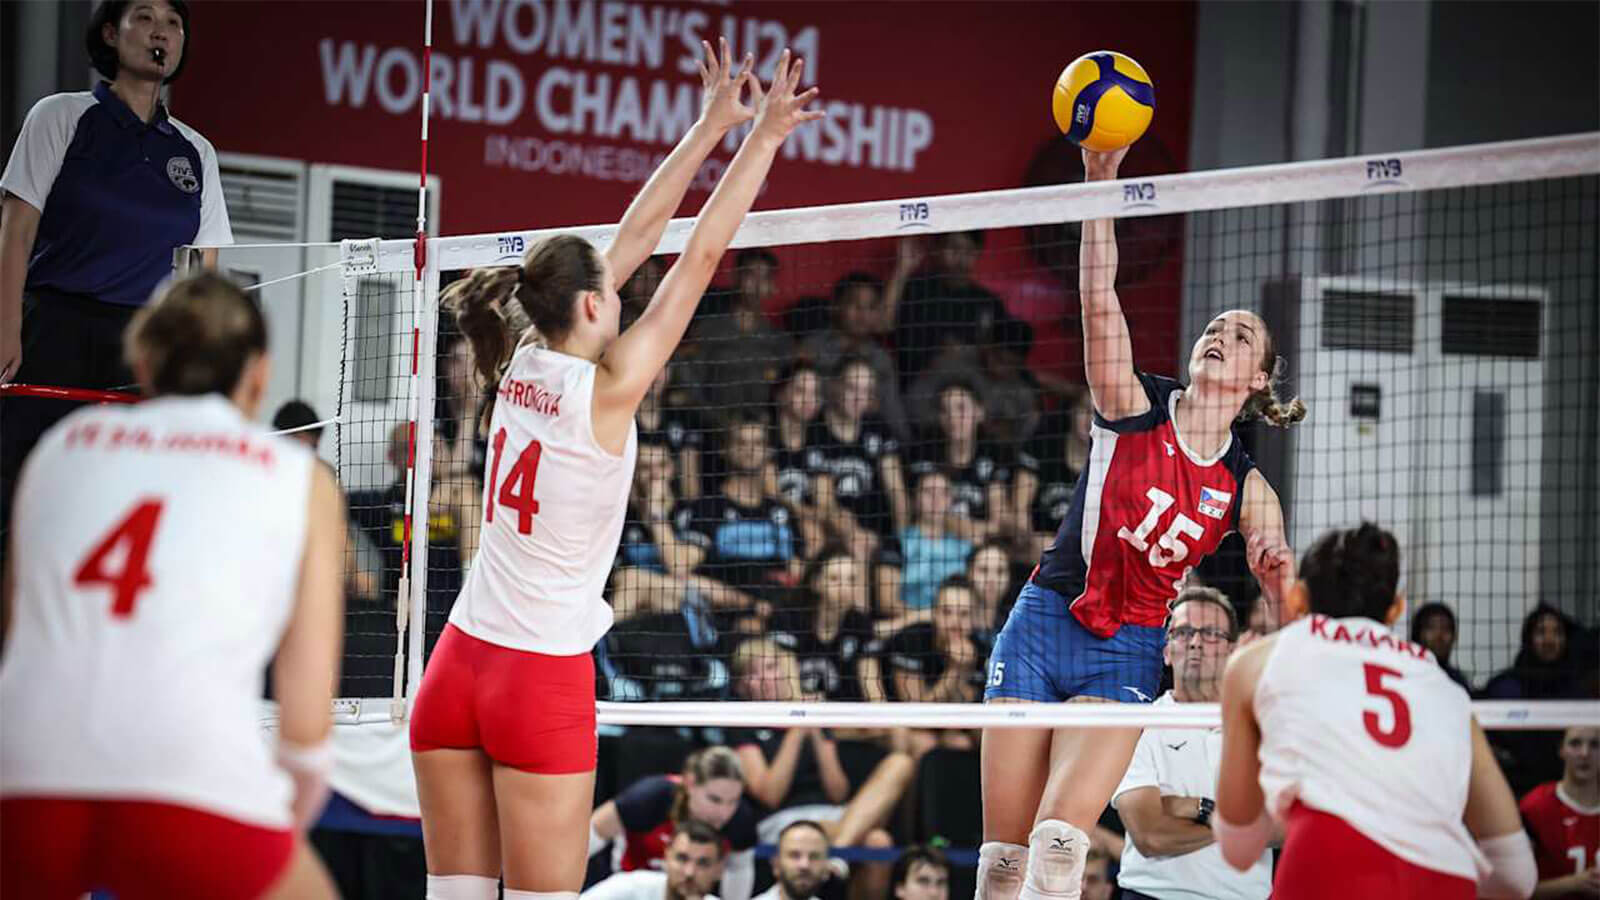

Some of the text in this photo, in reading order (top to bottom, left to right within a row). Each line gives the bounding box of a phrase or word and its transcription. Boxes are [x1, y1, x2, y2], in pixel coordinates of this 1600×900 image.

[451, 0, 820, 86] WOMEN'S U21
[320, 38, 934, 172] WORLD CHAMNSHIP
[900, 203, 929, 221] FIVB
[1366, 159, 1402, 180] FIVB
[498, 236, 524, 253] FIVB
[486, 427, 542, 535] 14
[72, 494, 165, 621] 4
[1117, 487, 1205, 568] 15
[1362, 661, 1413, 751] 5
